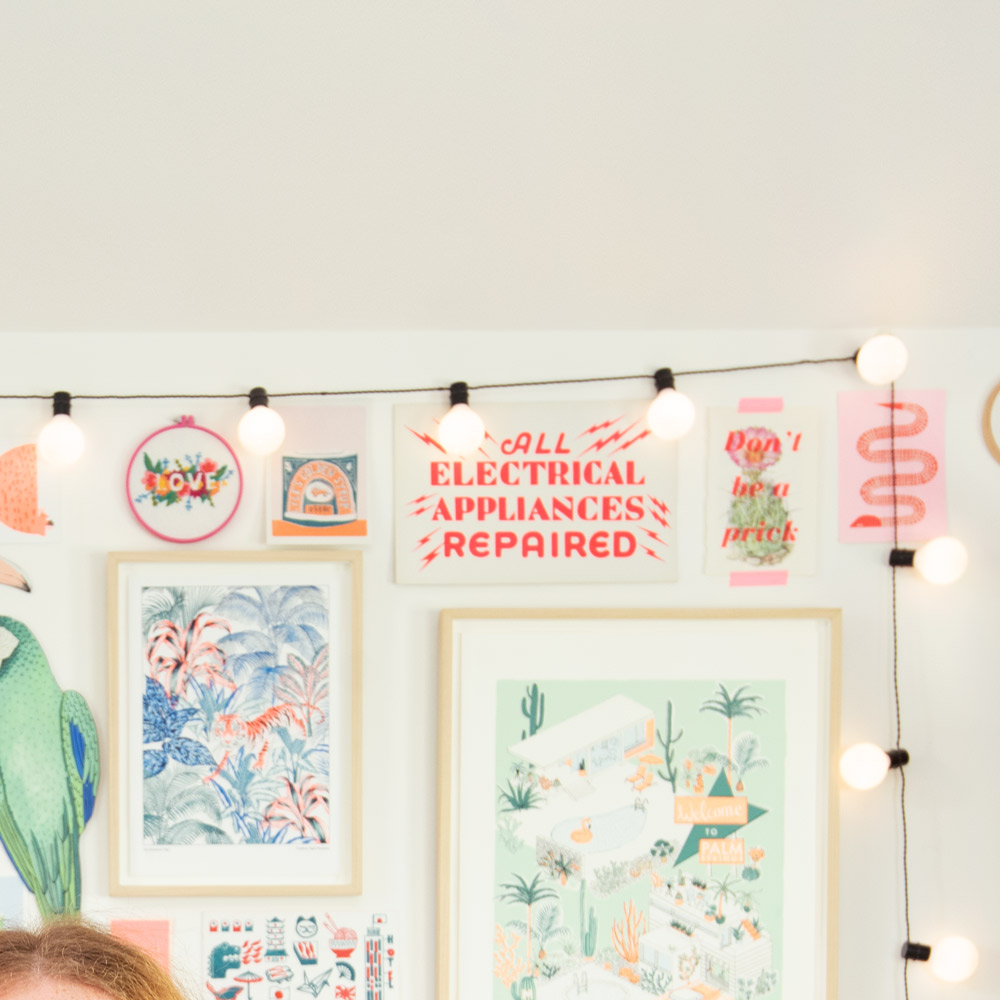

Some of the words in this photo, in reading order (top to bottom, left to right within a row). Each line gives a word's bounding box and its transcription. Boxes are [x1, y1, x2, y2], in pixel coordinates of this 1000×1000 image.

[500, 431, 571, 456] ALL
[724, 430, 803, 453] Don't
[155, 471, 218, 492] LOVE
[430, 460, 646, 487] ELECTRICAL
[732, 475, 764, 498] be
[772, 482, 790, 498] a
[430, 495, 646, 522] APPLIANCES
[443, 530, 637, 559] REPAIRED
[721, 520, 799, 548] prick
[676, 799, 743, 823] Welcome
[704, 827, 719, 837] TO
